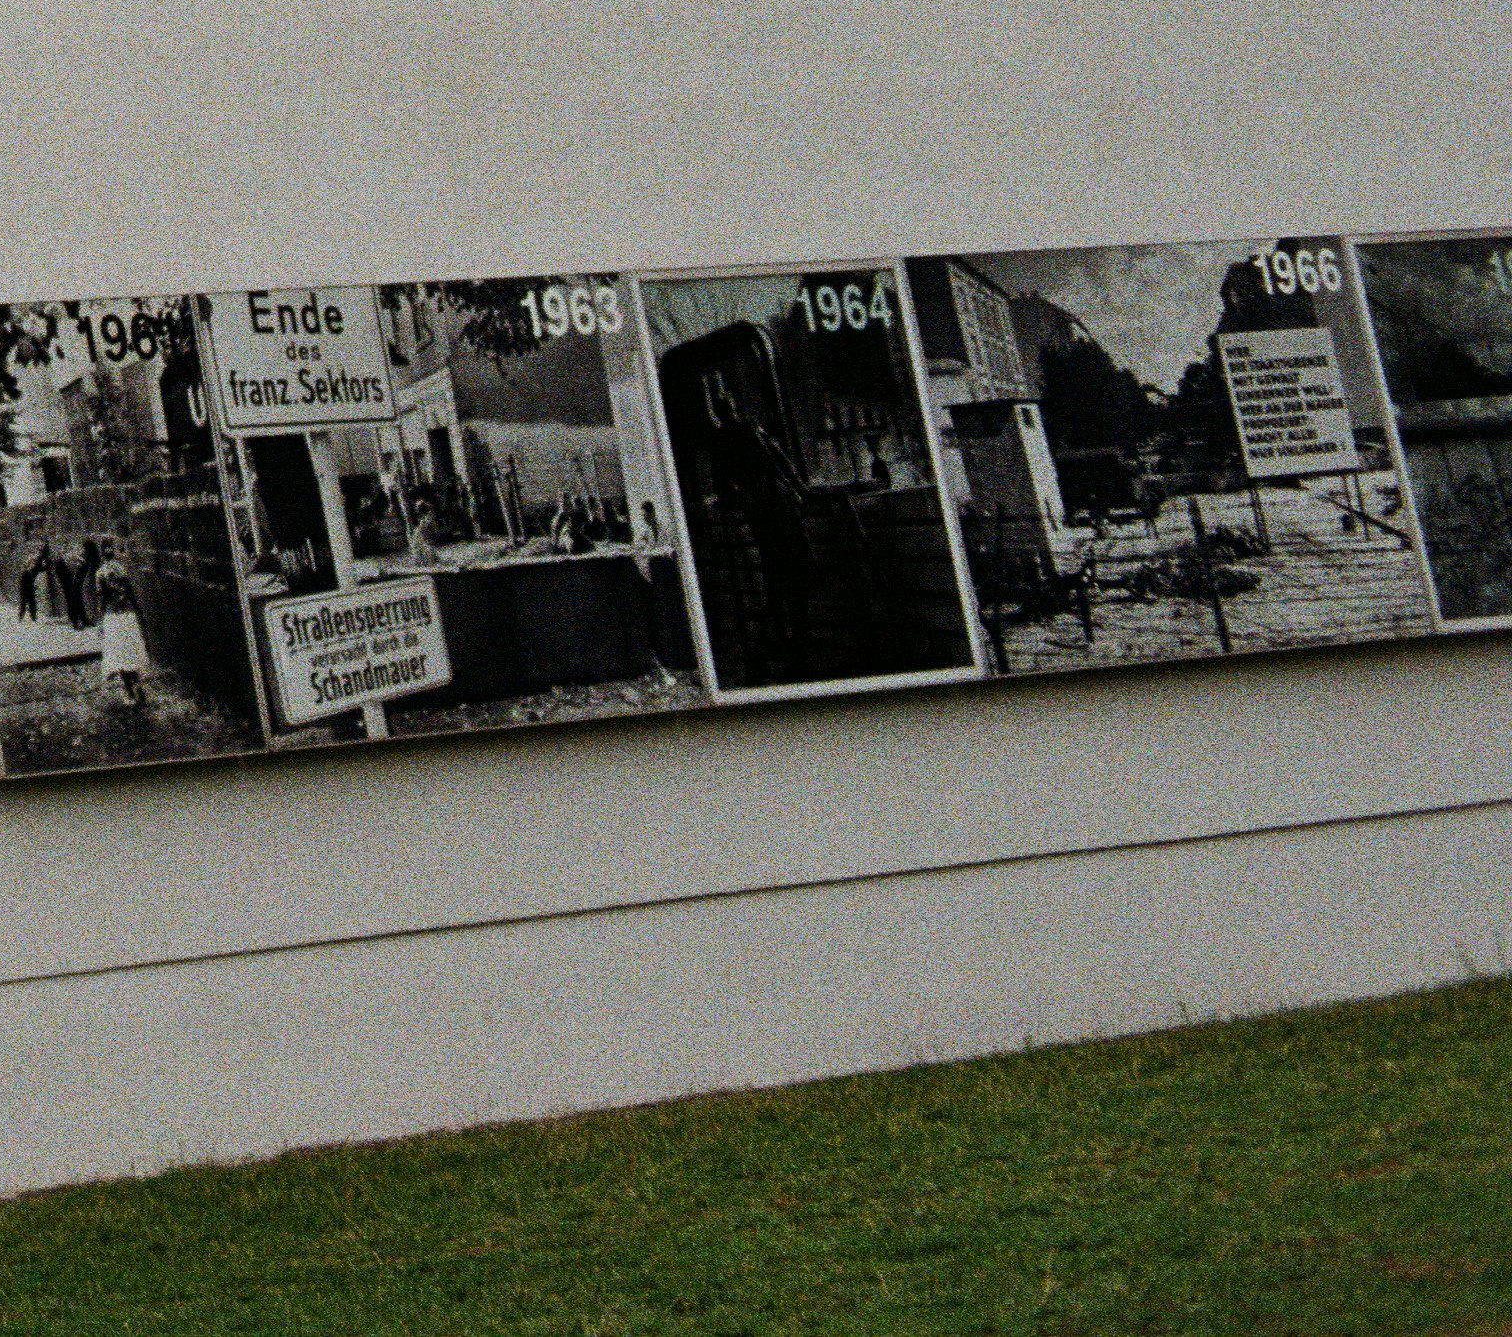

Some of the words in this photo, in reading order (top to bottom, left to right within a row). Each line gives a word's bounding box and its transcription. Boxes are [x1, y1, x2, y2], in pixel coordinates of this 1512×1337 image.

[1252, 246, 1342, 296] 1966
[248, 289, 344, 335] Ende
[520, 282, 624, 339] 1963
[796, 281, 893, 333] 1964
[285, 342, 322, 361] des
[298, 368, 384, 404] Sektors
[281, 595, 432, 647] Straßensperrung
[310, 655, 428, 704] Schandmauer
